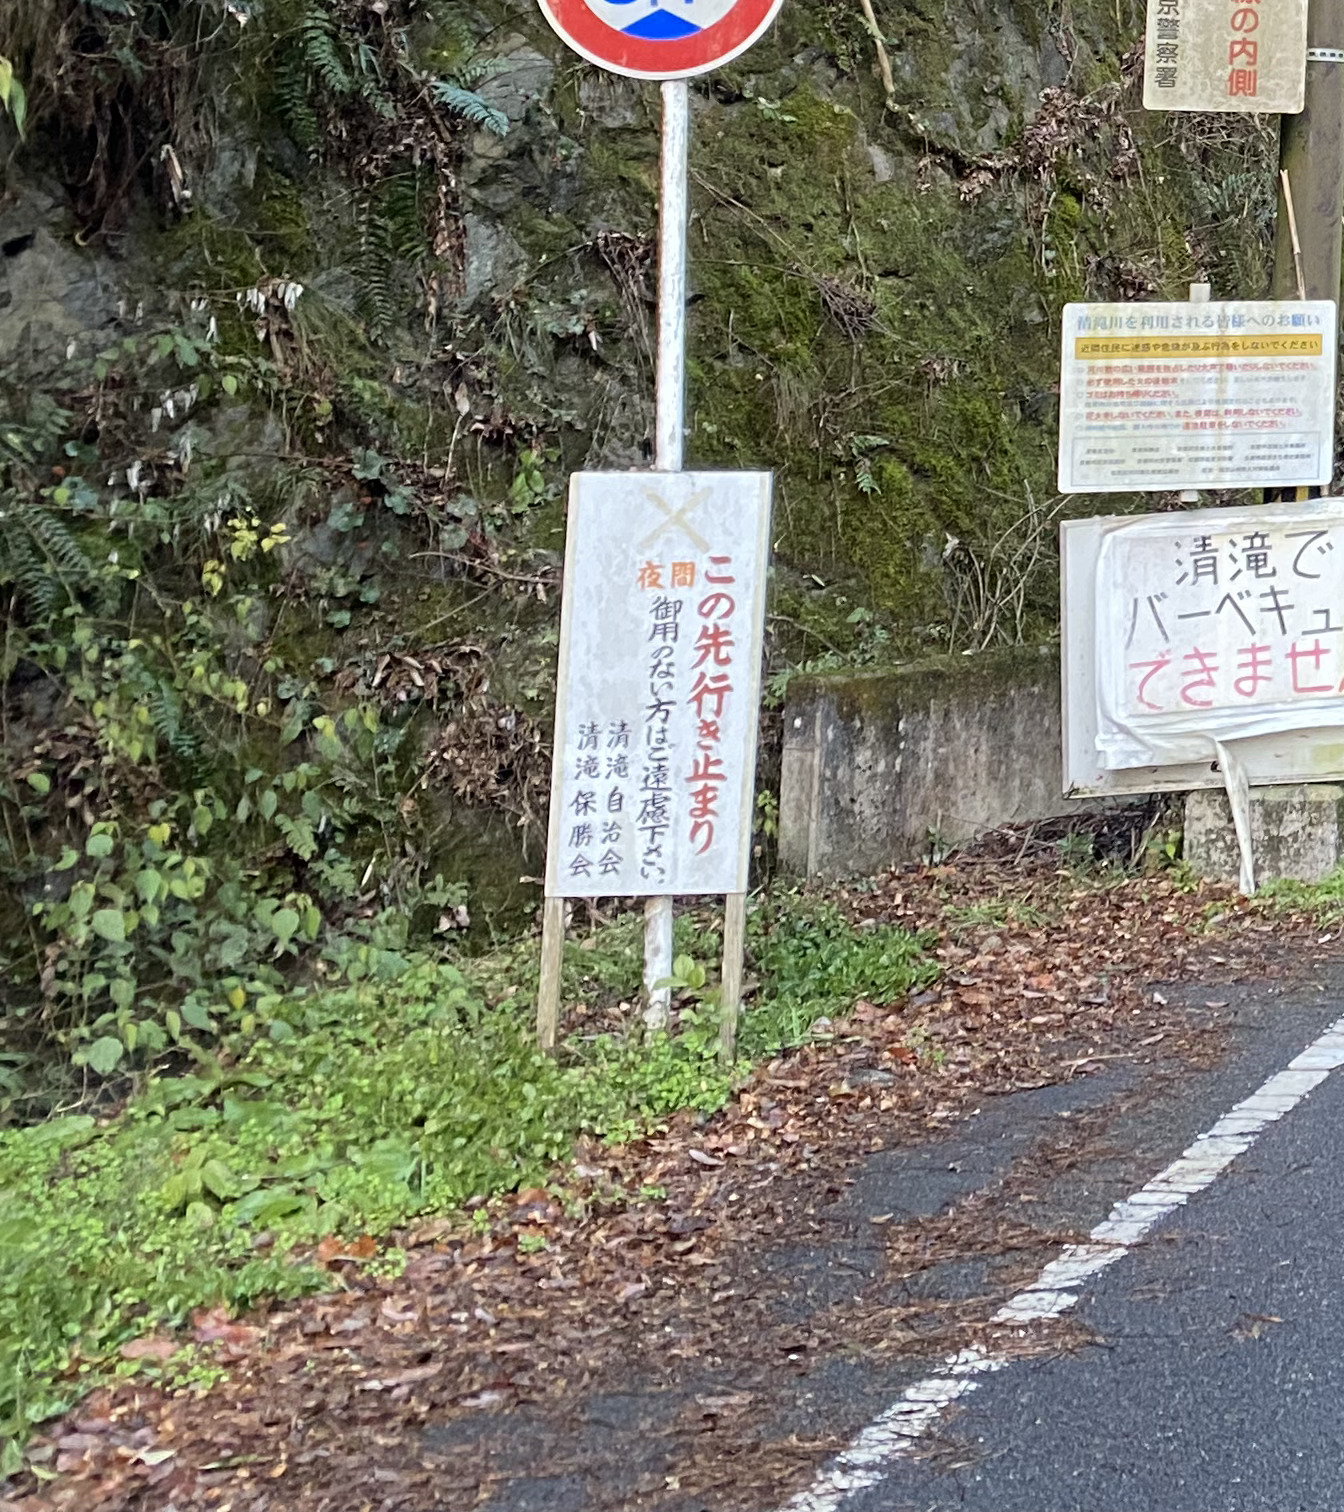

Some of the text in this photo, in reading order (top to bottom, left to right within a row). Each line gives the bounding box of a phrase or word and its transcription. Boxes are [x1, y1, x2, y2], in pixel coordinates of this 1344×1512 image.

[636, 560, 698, 591] 夜間
[1174, 529, 1335, 586] 清滝で
[686, 556, 736, 856] この先行き止まり
[567, 721, 605, 879] 清滝保勝会
[597, 719, 633, 877] 清滝自治会
